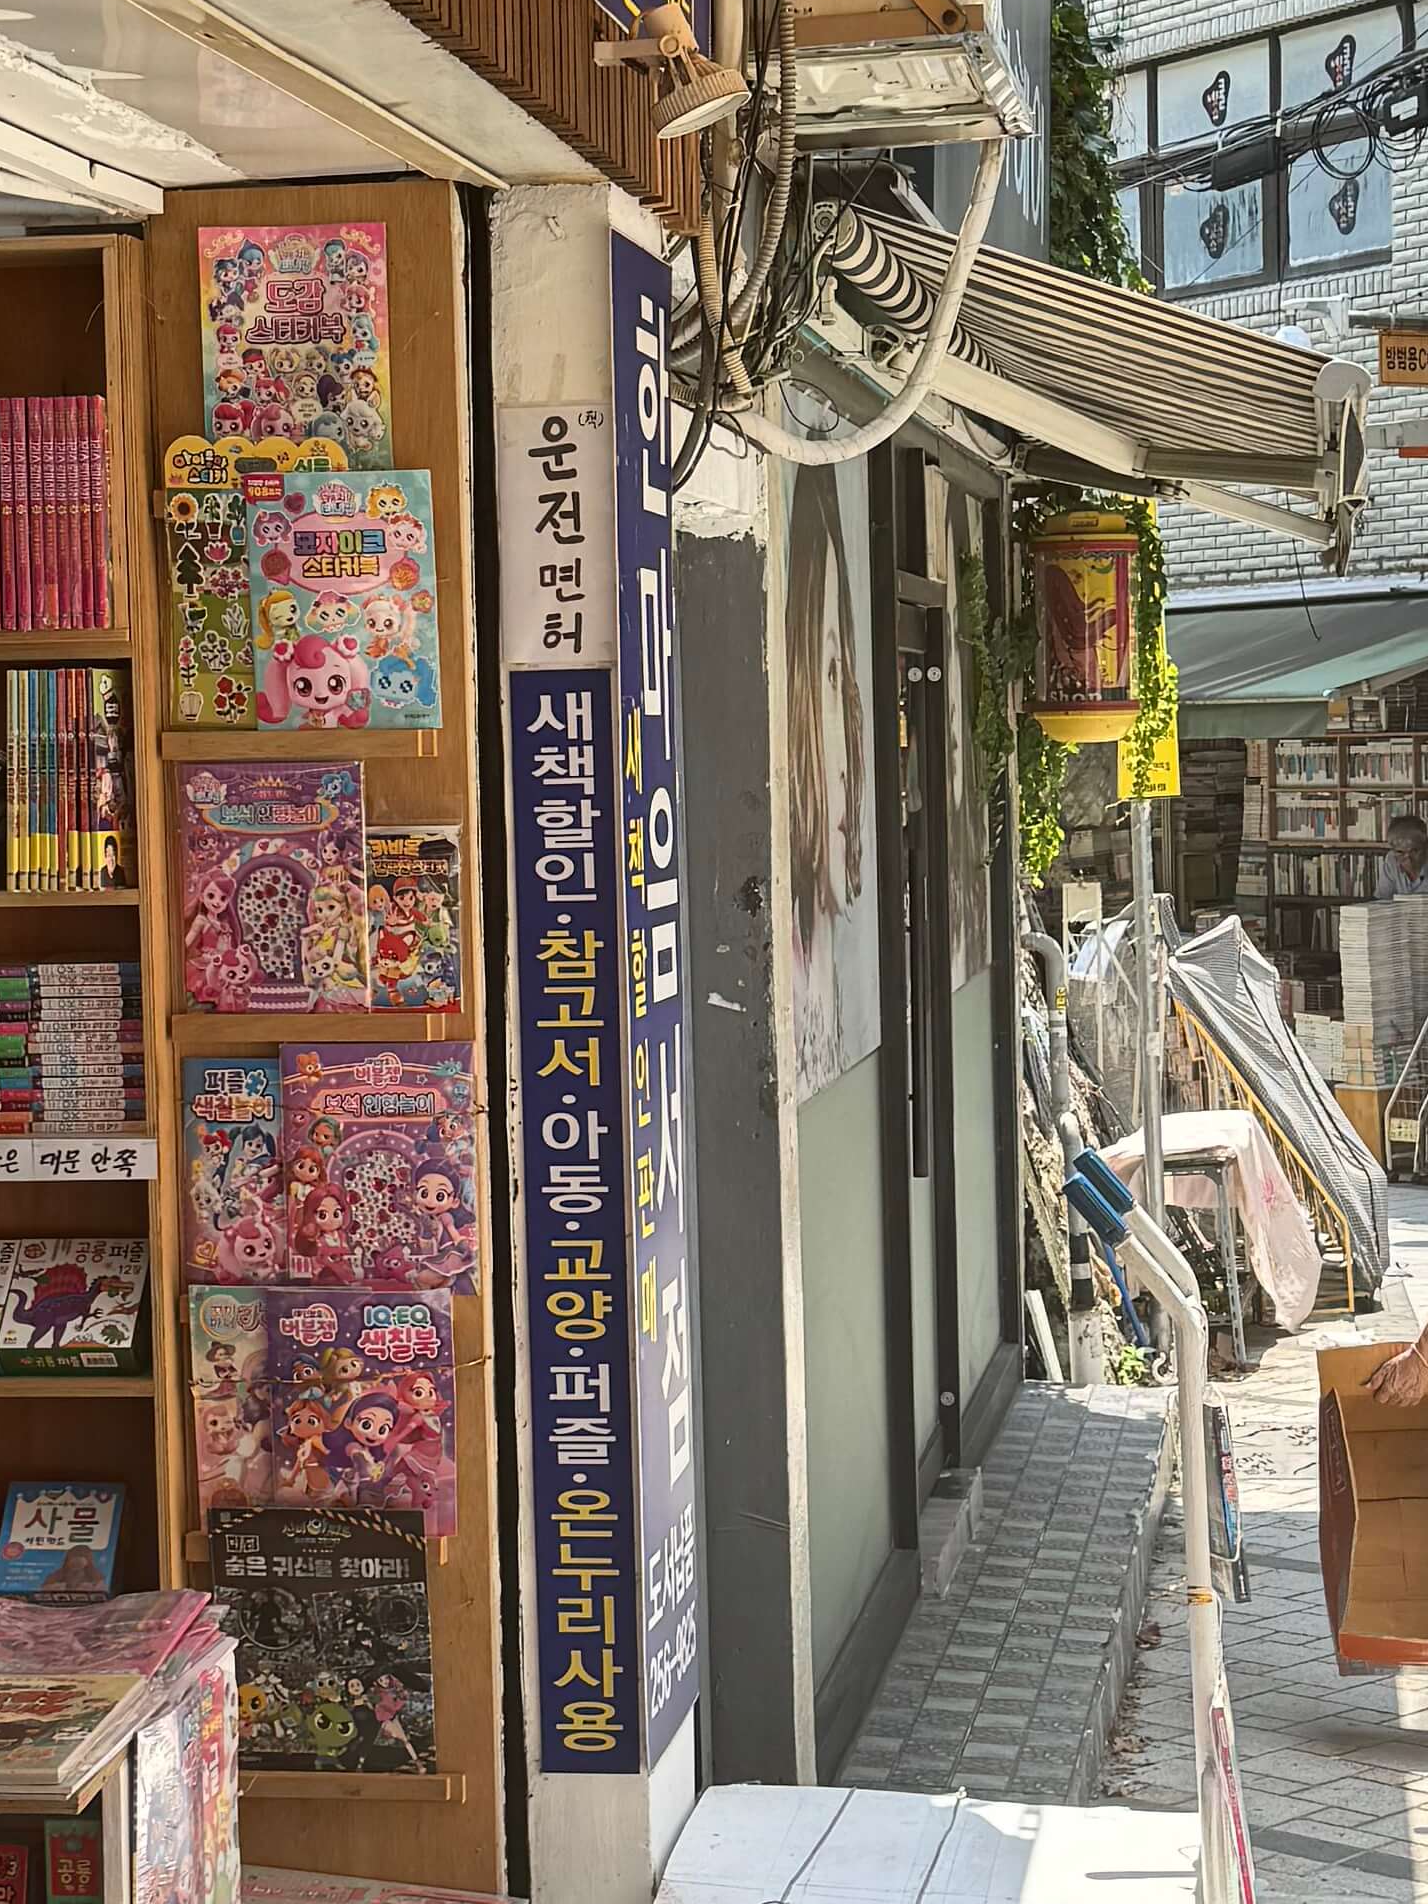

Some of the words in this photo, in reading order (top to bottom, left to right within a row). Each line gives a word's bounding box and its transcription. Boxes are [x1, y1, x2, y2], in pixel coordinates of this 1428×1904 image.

[264, 278, 326, 315] 도감
[244, 313, 348, 347] 스티커북
[187, 467, 229, 485] 스티커
[293, 529, 388, 556] 모자이크
[527, 413, 587, 656] 운전면허
[300, 556, 381, 579] 스티커북
[635, 293, 695, 1488] 한마음서점
[535, 926, 603, 1088] 참고서
[622, 702, 659, 1347] 새책할인판매
[203, 1068, 248, 1093] 퍼즐
[323, 1093, 363, 1117] 보석
[362, 1093, 436, 1116] 인형놀이
[91, 1142, 140, 1178] 안쪽
[540, 1108, 611, 1219] 아동
[74, 1240, 108, 1266] 공룡
[108, 1240, 146, 1266] 퍼즐
[542, 1236, 614, 1344] 교양
[279, 1315, 338, 1345] 버블젬
[357, 1326, 442, 1363] 색칠북
[546, 1361, 618, 1469] 퍼즐
[23, 1499, 101, 1535] 사물
[224, 1556, 268, 1578] 숨은
[272, 1557, 333, 1579] 귀신을
[339, 1556, 411, 1579] 찾아라!
[647, 1510, 696, 1626] 도서납품
[551, 1487, 625, 1755] 온누리사용
[648, 1599, 699, 1720] 256-9825
